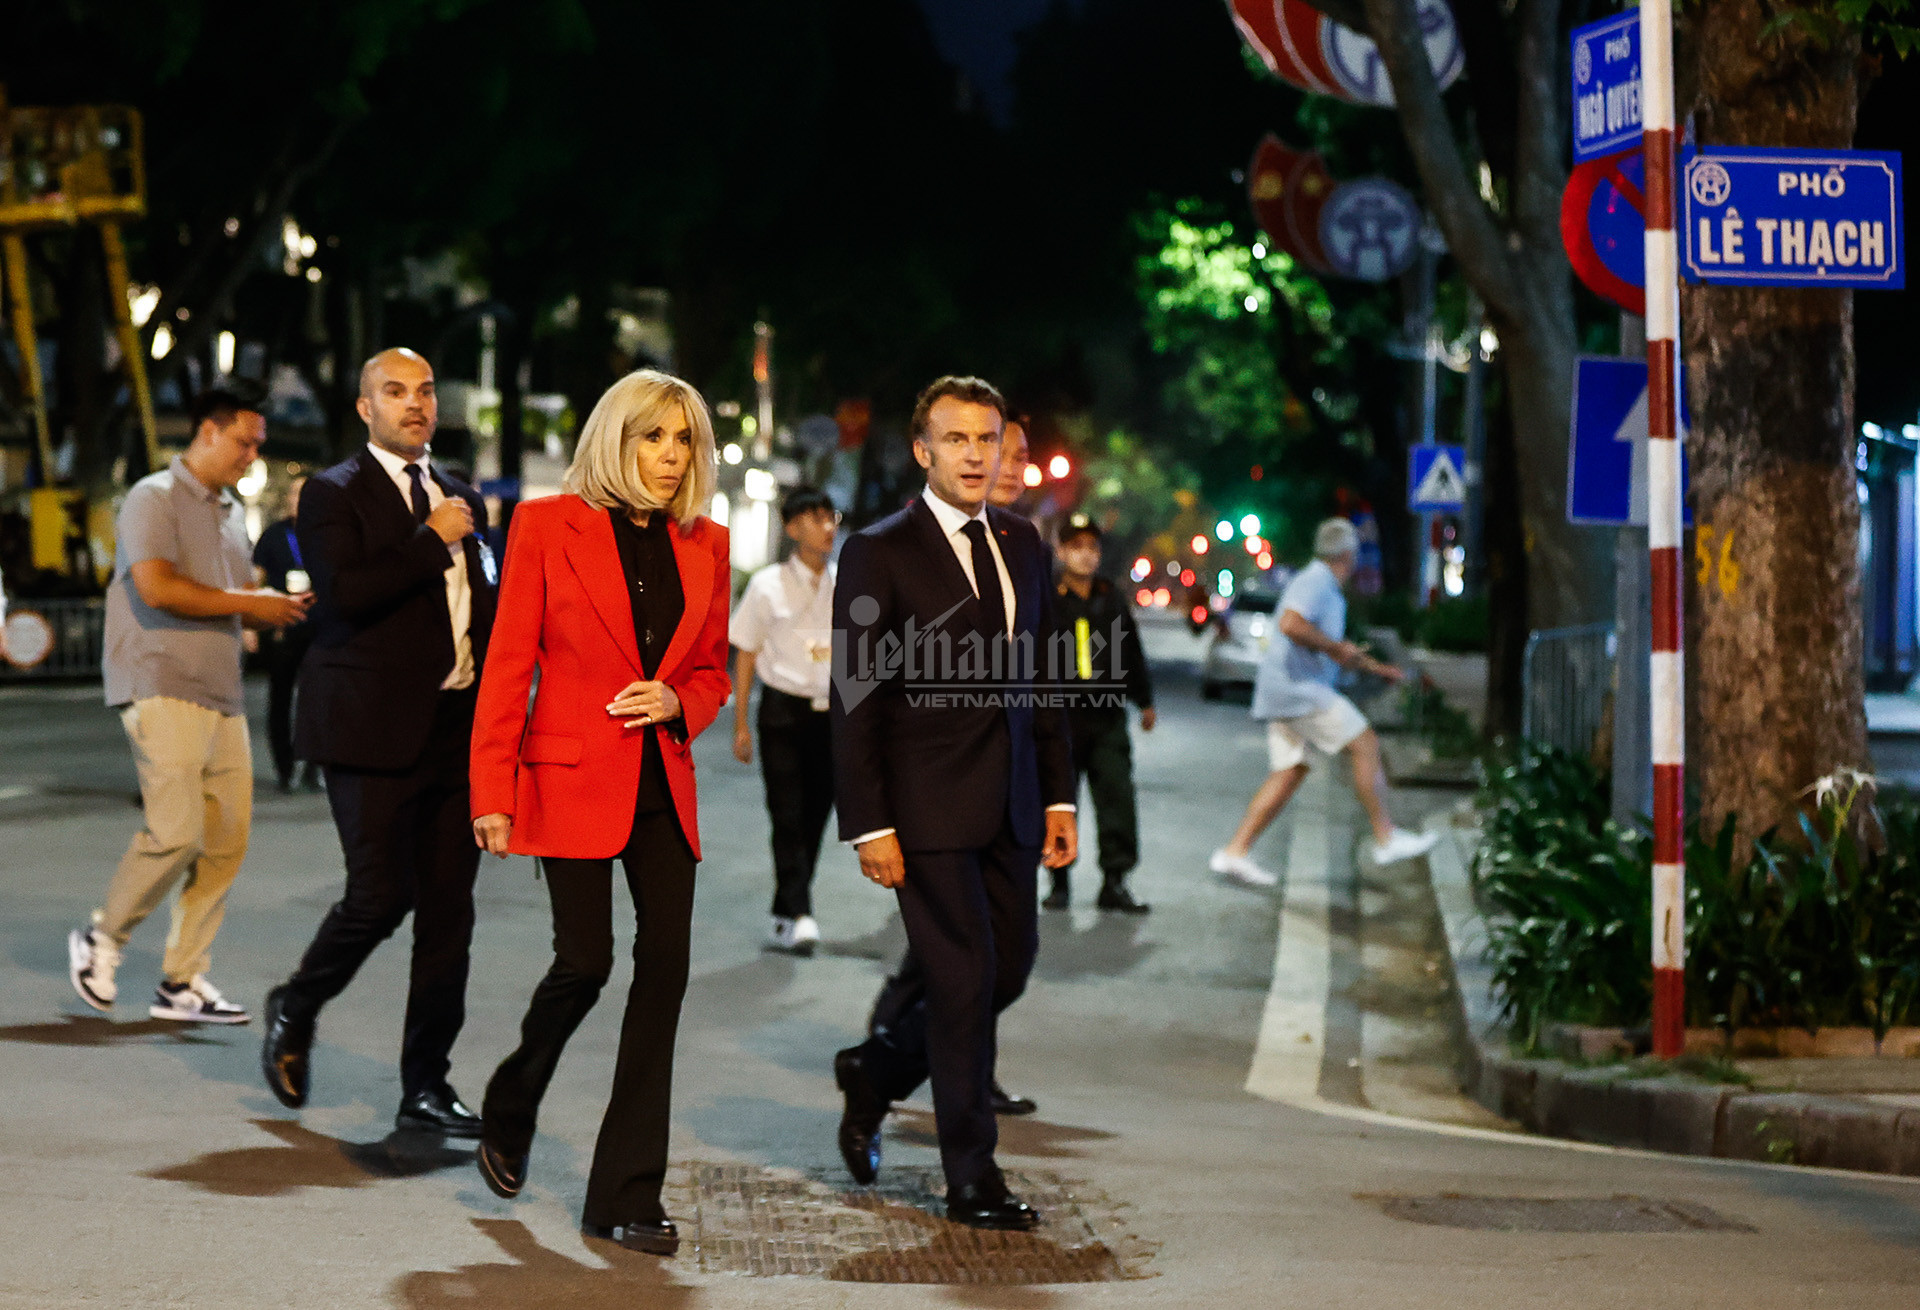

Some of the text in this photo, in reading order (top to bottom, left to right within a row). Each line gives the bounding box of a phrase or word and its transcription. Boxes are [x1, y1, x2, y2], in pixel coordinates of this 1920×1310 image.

[1778, 162, 1846, 198] PHỐ
[1699, 206, 1886, 277] LÊ THẠCH
[1696, 524, 1739, 595] 56
